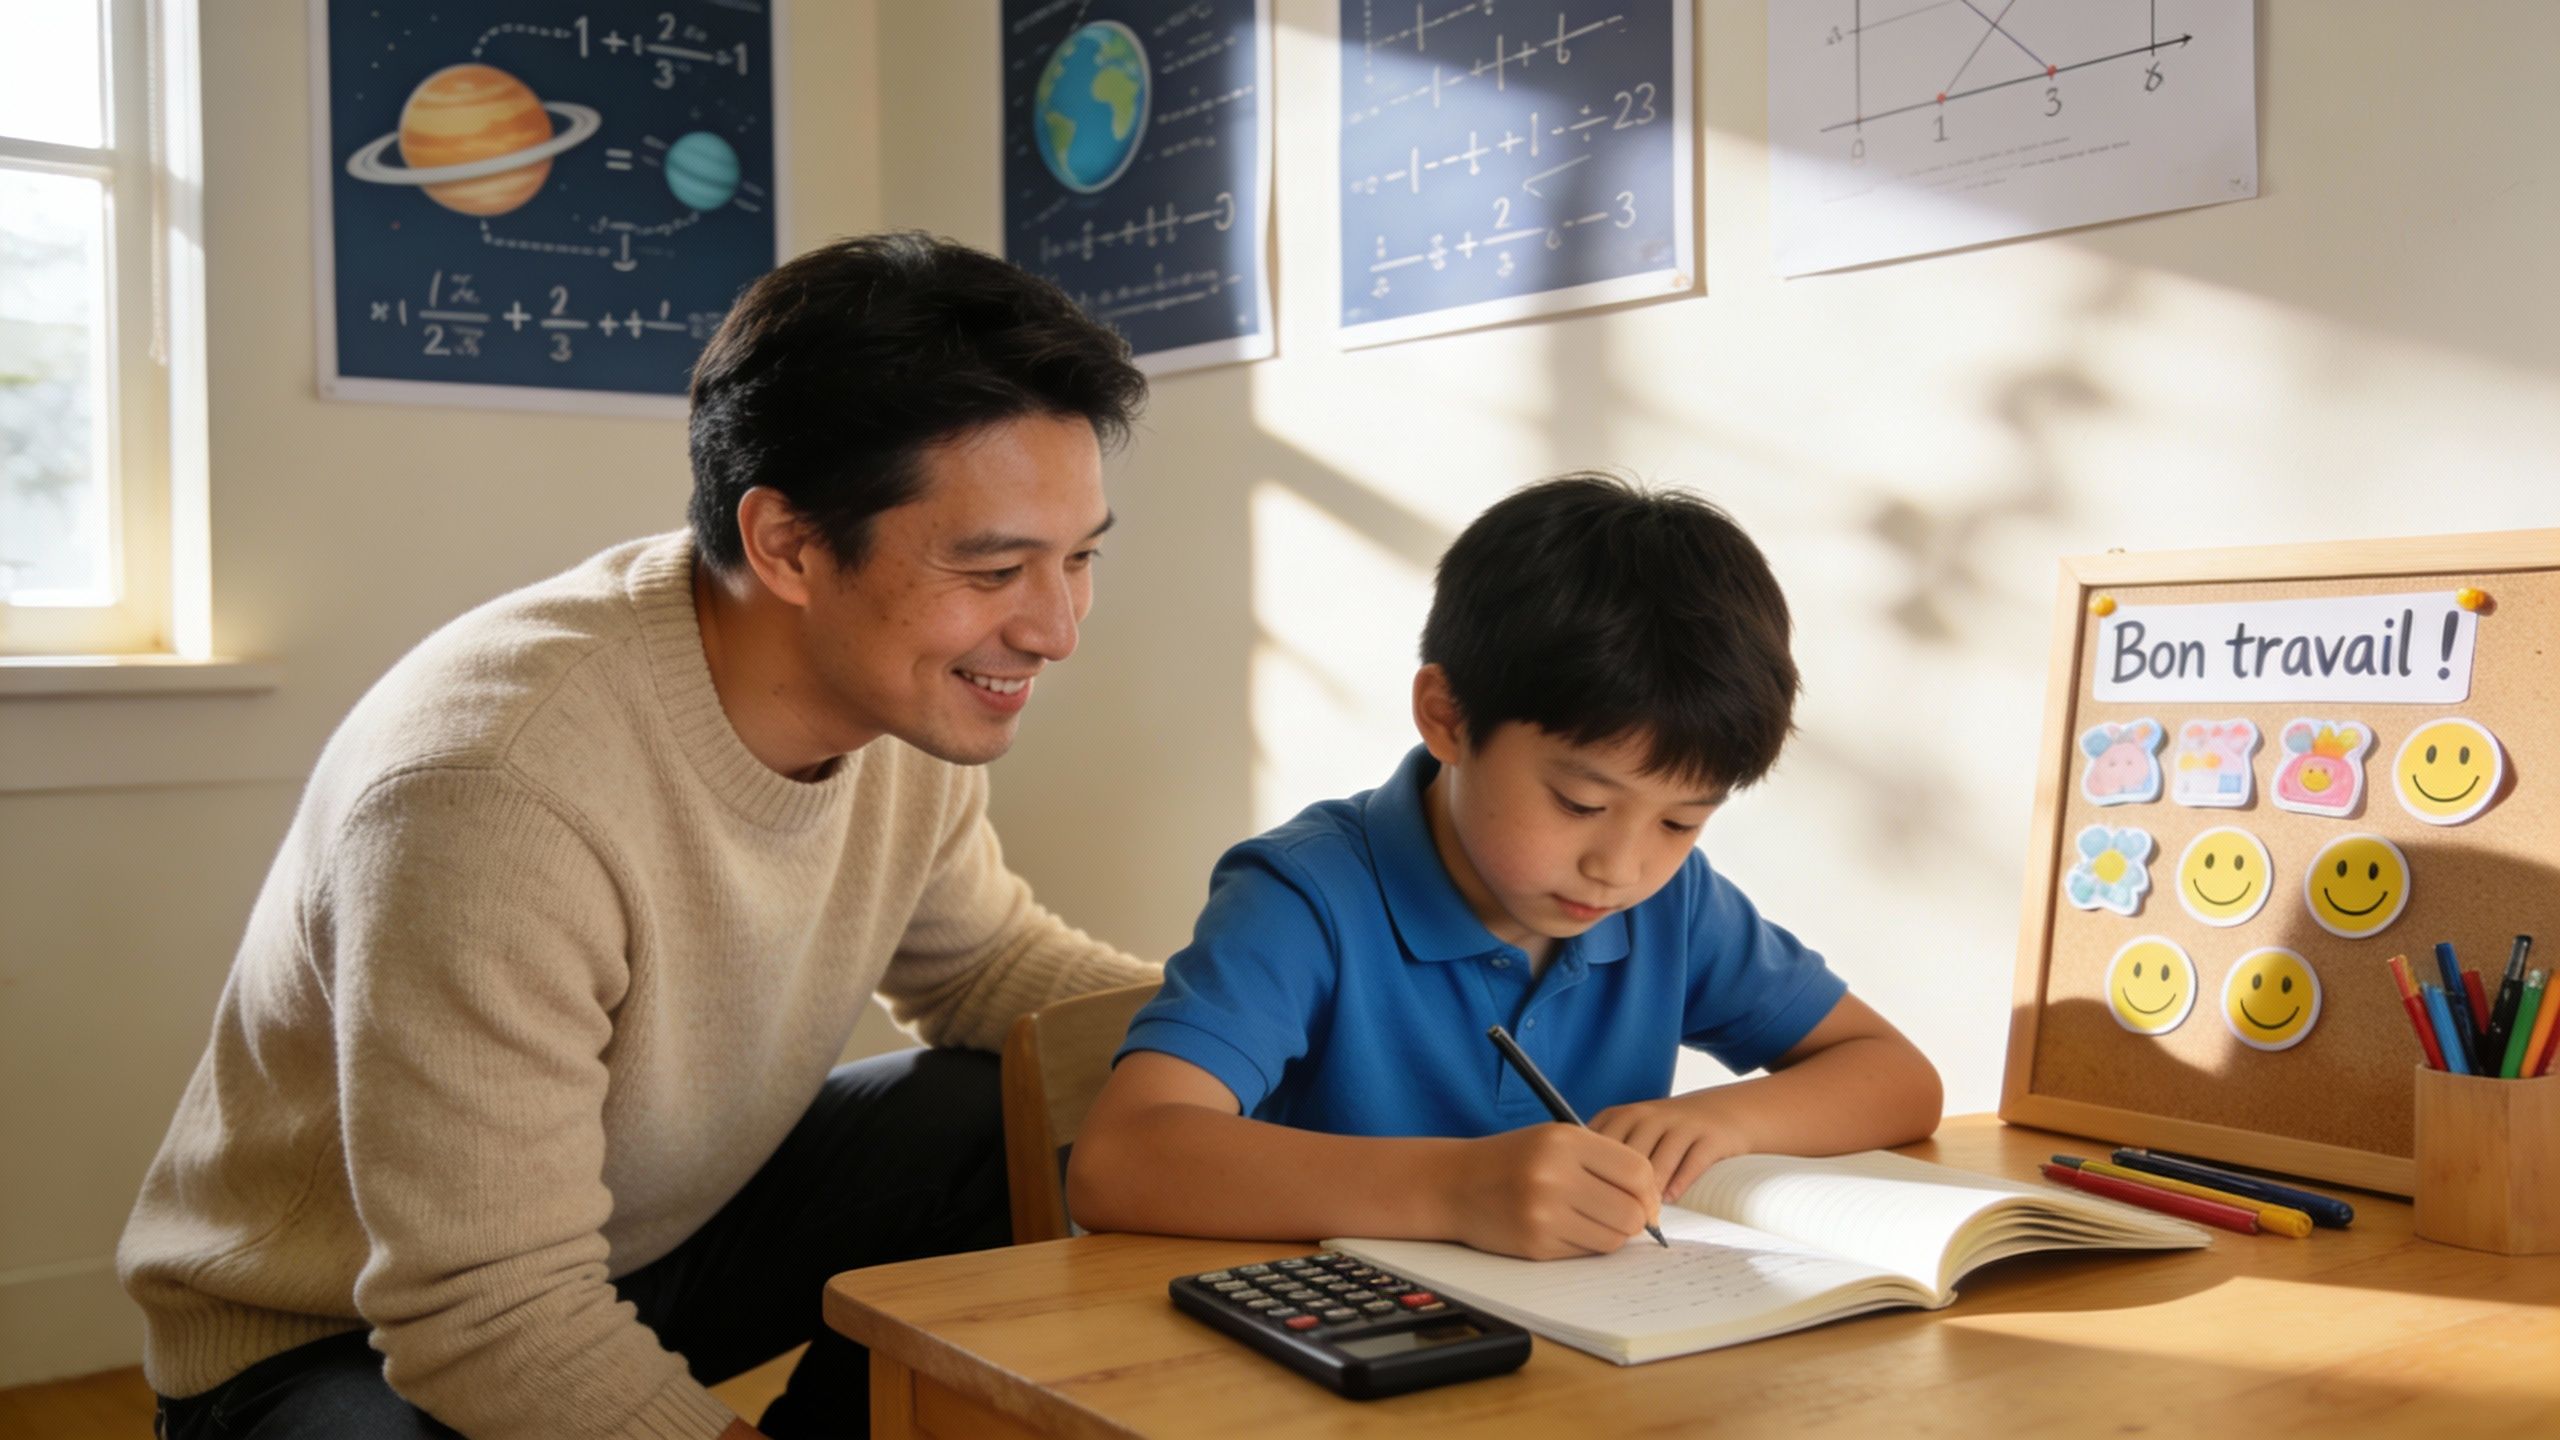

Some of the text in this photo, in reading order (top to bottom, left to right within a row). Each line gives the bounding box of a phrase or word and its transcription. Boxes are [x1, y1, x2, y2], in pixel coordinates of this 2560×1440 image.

[574, 15, 589, 60] 1
[657, 12, 677, 41] 2
[652, 58, 676, 91] 3
[1612, 81, 1657, 131] 23
[1932, 114, 1951, 143] 1
[2043, 87, 2063, 117] 3
[1492, 196, 1512, 230] 2
[1614, 190, 1637, 230] 3
[549, 284, 569, 317] 2
[423, 323, 451, 357] 2
[549, 333, 573, 363] 3
[2111, 608, 2460, 684] Bon travail !
